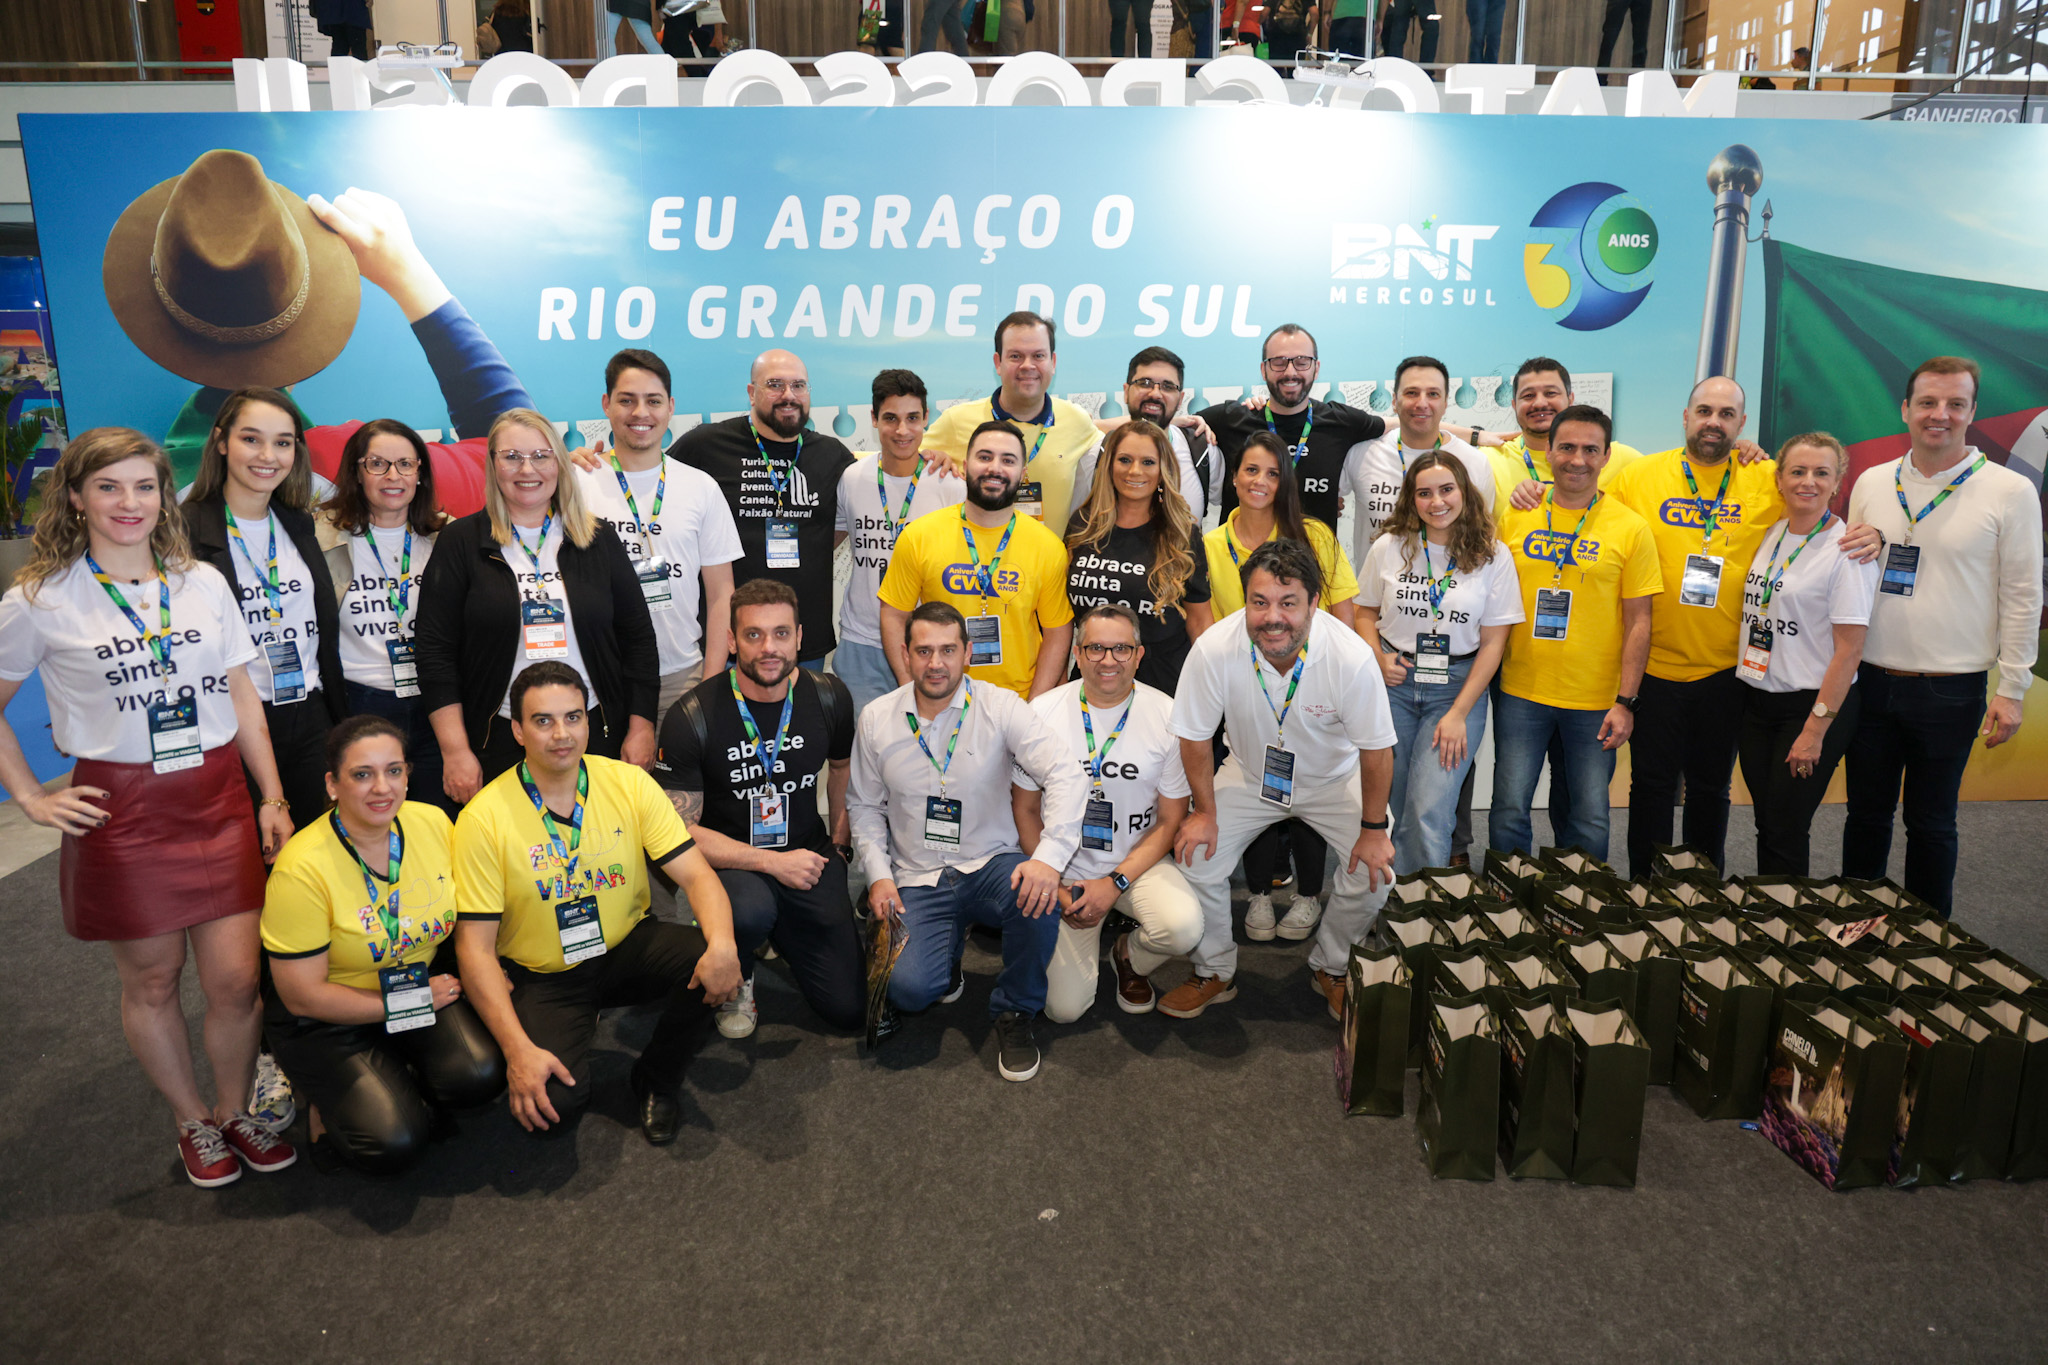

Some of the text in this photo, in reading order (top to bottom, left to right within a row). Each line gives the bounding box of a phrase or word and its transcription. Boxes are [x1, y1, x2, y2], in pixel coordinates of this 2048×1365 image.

[1903, 107, 2019, 123] BANHEIROS
[648, 194, 1135, 265] EU ABRAÇO O
[1608, 233, 1650, 249] ANOS
[1331, 221, 1501, 281] BNT
[1329, 286, 1496, 306] MERCOSUL
[538, 283, 1262, 340] RIO GRANDE DO SUL
[1304, 478, 1329, 493] RS
[740, 496, 777, 506] Canela,
[739, 508, 773, 518] Paixão
[1718, 503, 1742, 518] 52
[1529, 540, 1566, 559] CVC
[1577, 539, 1600, 555] 52
[855, 556, 888, 569] viva
[1076, 554, 1146, 576] abrace
[1576, 554, 1598, 562] ANOS
[997, 570, 1019, 585] 52
[1070, 571, 1121, 592] sinta
[1397, 605, 1428, 619] viva
[1449, 610, 1470, 624] RS
[283, 627, 297, 640] o
[353, 621, 400, 637] viva
[1764, 618, 1773, 630] o
[1777, 618, 1799, 636] RS
[94, 629, 202, 660] abrce
[105, 659, 178, 687] sinta
[177, 685, 196, 699] o
[202, 675, 229, 696] RS
[782, 780, 797, 793] o
[1129, 806, 1153, 835] RS
[565, 944, 581, 953] AGENTE
[585, 938, 603, 947] VIAGENS
[388, 1011, 407, 1020] AGENTE
[411, 1007, 432, 1015] VIAGENS
[1783, 1027, 1811, 1055] CANELA
